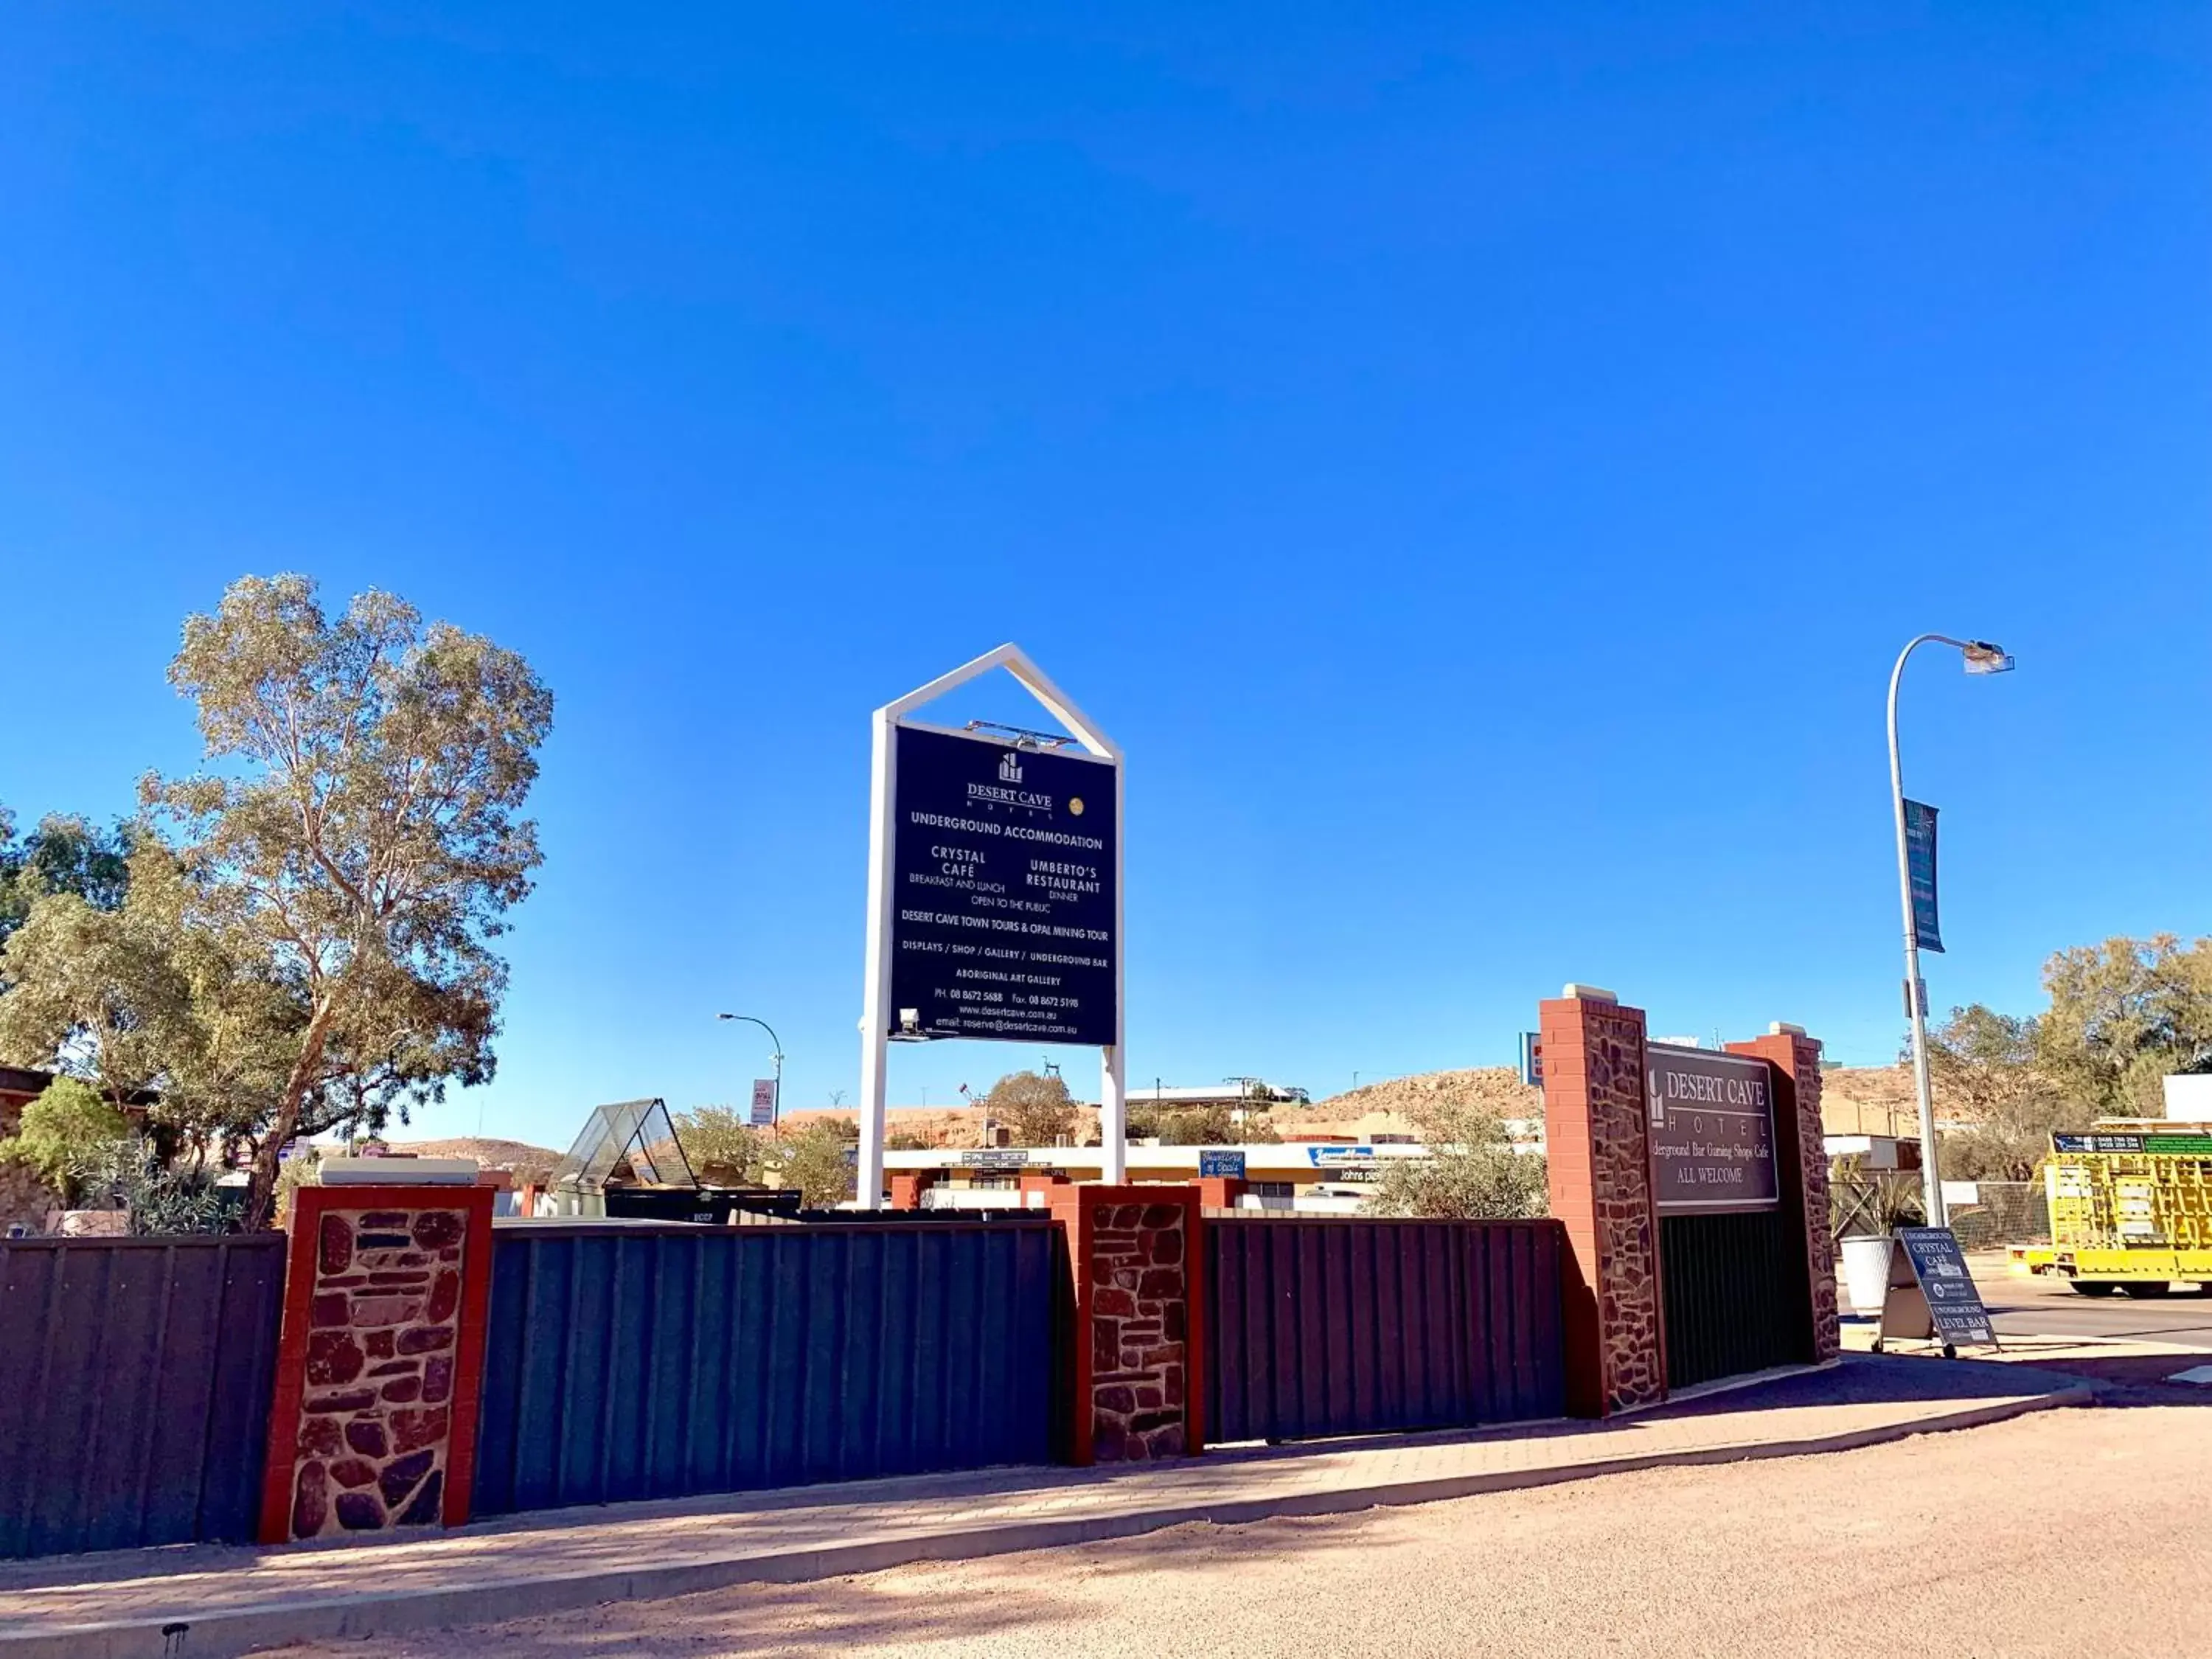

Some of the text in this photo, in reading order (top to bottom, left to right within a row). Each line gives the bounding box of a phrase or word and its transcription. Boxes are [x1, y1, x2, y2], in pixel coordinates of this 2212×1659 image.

[967, 783, 1052, 807] DESERT CAVE
[911, 811, 1102, 849] UNDERGROUND ACCOMMODATION
[931, 846, 986, 863] CRYSTAL
[942, 862, 974, 877] CAFÉ
[1030, 859, 1097, 878] UMBERTO'S
[909, 872, 1005, 894] BREAKFAST AND LUNCH
[1026, 874, 1100, 894] RESTAURANT
[971, 895, 1051, 914] OPEN TO THE PUBLIC
[1048, 890, 1079, 902] DINNER
[902, 909, 1108, 941] DESERT CAVE TOWN TOURS & OPAL MINING TOUR
[902, 940, 943, 952] DISPLAYS
[952, 945, 975, 955] SHOP
[984, 947, 1020, 959] GALLERY
[1030, 952, 1091, 966] UNDERGROUND
[1092, 959, 1108, 968] BAR
[956, 968, 1061, 986] ABORIGINAL ART GALLERY
[950, 989, 961, 999] 08
[962, 990, 981, 1001] 8672
[1029, 995, 1039, 1005] 08
[1040, 996, 1058, 1006] 8672
[959, 1005, 1057, 1020] www.desertcave.com.au
[1666, 1071, 1764, 1105] DESERT CAVE
[1669, 1115, 1766, 1136] HOTEL
[1653, 1140, 1690, 1159] derground
[1692, 1141, 1705, 1157] Bar
[1707, 1142, 1732, 1160] Gaming
[1733, 1144, 1753, 1161] Shops
[1677, 1167, 1744, 1183] ALL WELCOME
[1912, 1242, 1953, 1253] CRYSTAL
[1933, 1306, 1981, 1314] UNDERGROUND
[1938, 1317, 1989, 1329] LEVEL BAR
